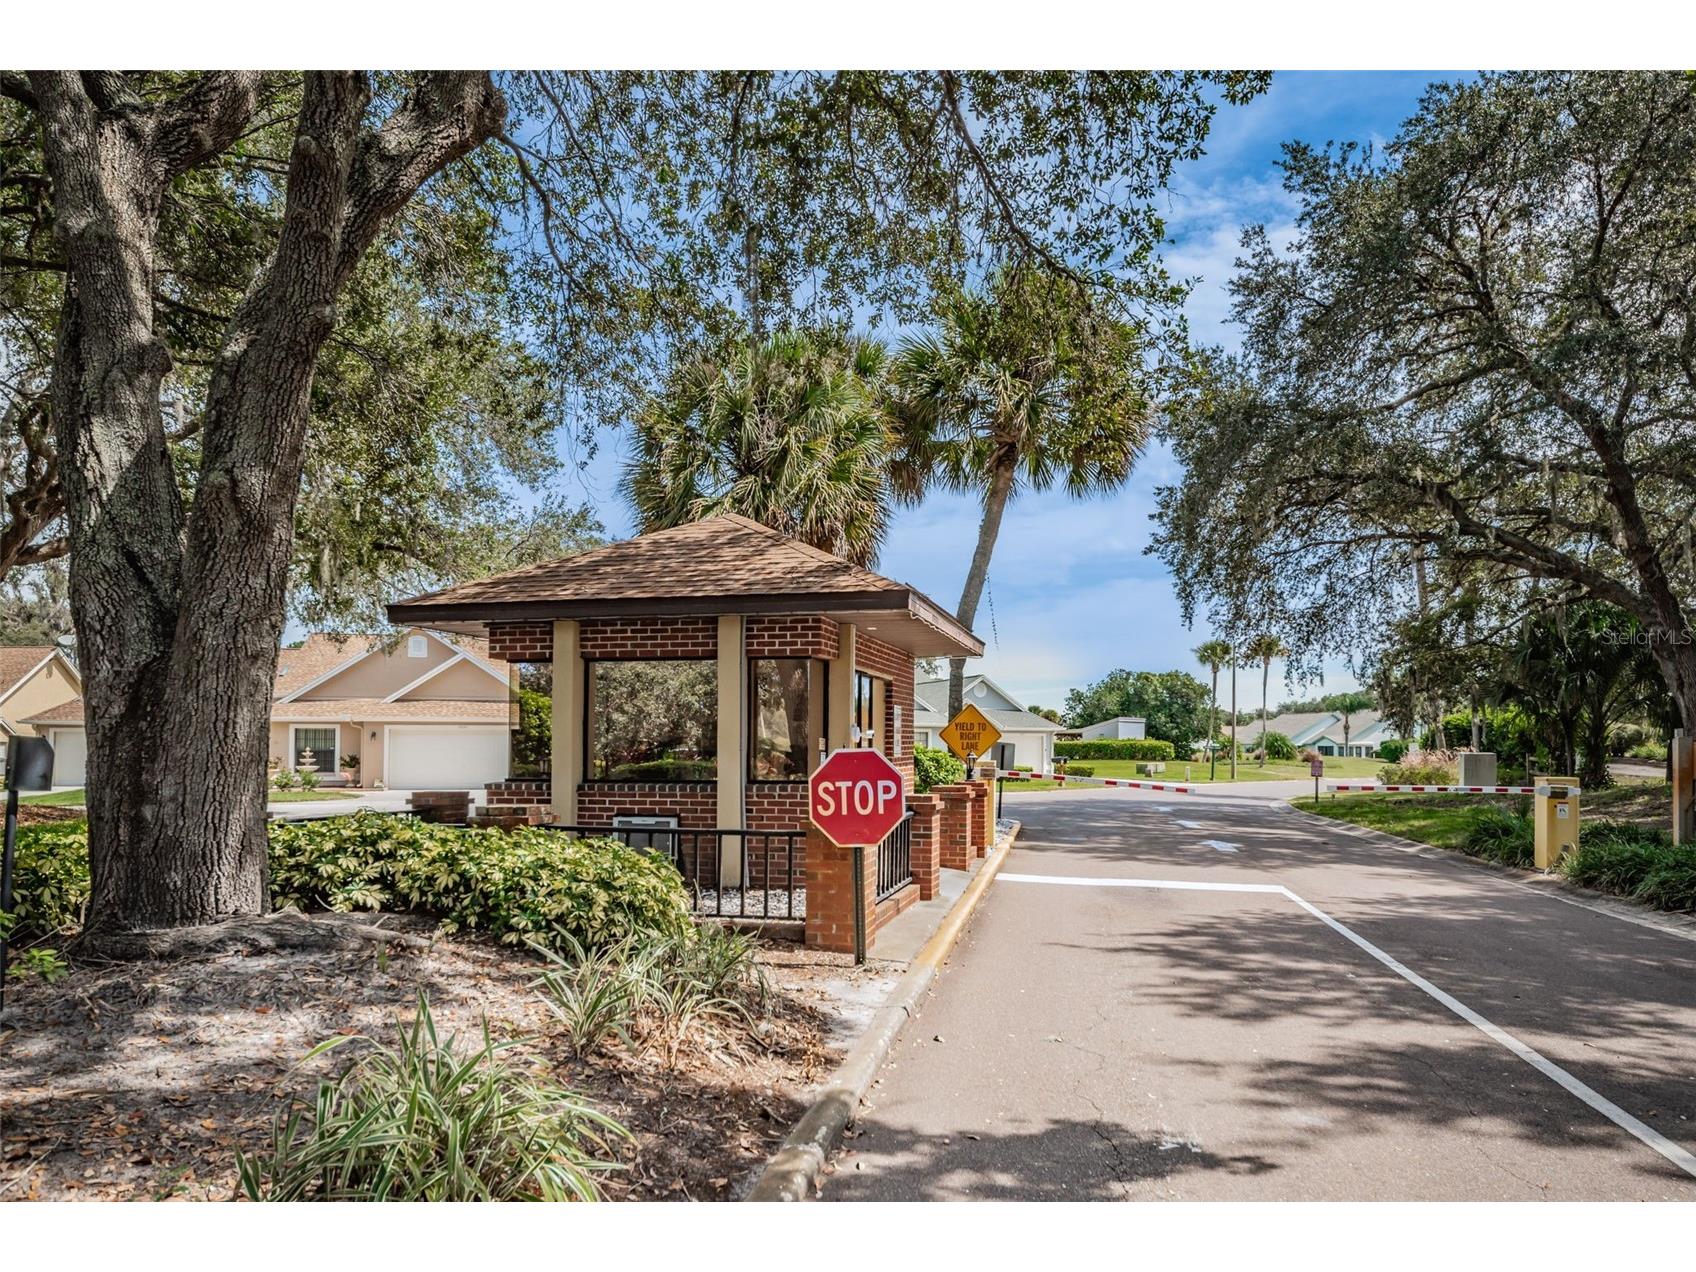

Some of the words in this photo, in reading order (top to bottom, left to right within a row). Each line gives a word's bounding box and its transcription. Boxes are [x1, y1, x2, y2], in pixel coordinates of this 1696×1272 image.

[955, 722, 975, 731] YIELD
[978, 722, 987, 731] TO
[960, 732, 981, 741] RIGHT
[961, 742, 980, 750] LANE
[817, 780, 897, 817] STOP
